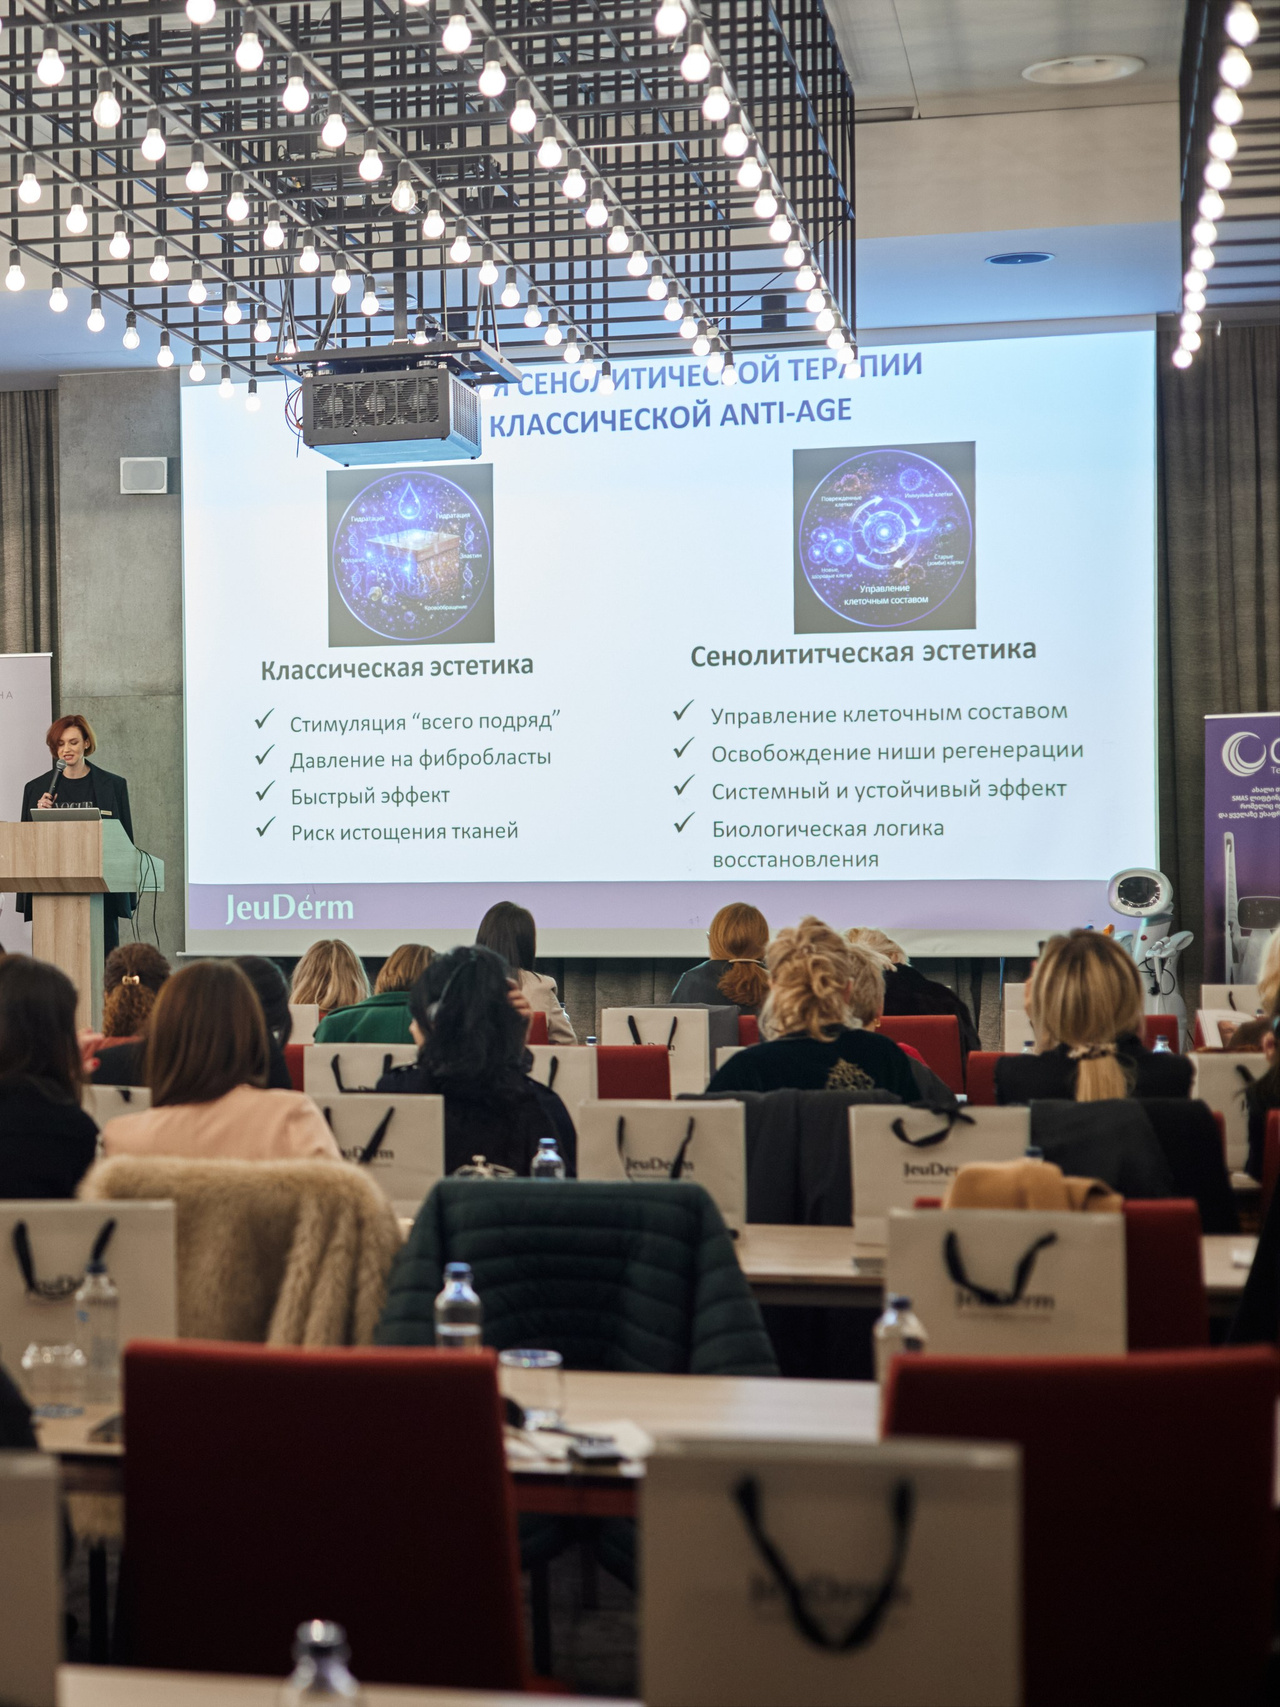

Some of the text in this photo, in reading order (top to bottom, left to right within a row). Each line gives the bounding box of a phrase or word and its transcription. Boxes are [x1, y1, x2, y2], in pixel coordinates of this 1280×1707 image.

[518, 354, 779, 396] СЕНОЛИТИЧЕСОЙ
[788, 352, 922, 381] ТЕРПИИ
[490, 398, 852, 437] КЛАССИЧЕСКОЙ ANTI-AGE
[844, 596, 928, 605] клеточным составом
[860, 585, 910, 594] Управление
[691, 642, 1036, 667] Сенолититческая эстетика
[262, 658, 533, 680] Классическая эстетика
[291, 709, 560, 735] Стимуляция “всего подряд”
[711, 706, 1067, 728] Управление клеточным составом
[290, 748, 550, 773] Давление на фибробласты
[712, 744, 1083, 765] Освобождение ниши регенерации
[292, 786, 450, 808] Быстрый эффект
[713, 778, 1067, 802] Системный и устойчивый эффект
[293, 821, 517, 843] Риск истощения тканей
[714, 821, 944, 837] Биологическая логика
[714, 855, 878, 867] восстановления
[226, 894, 353, 925] JeuDérm
